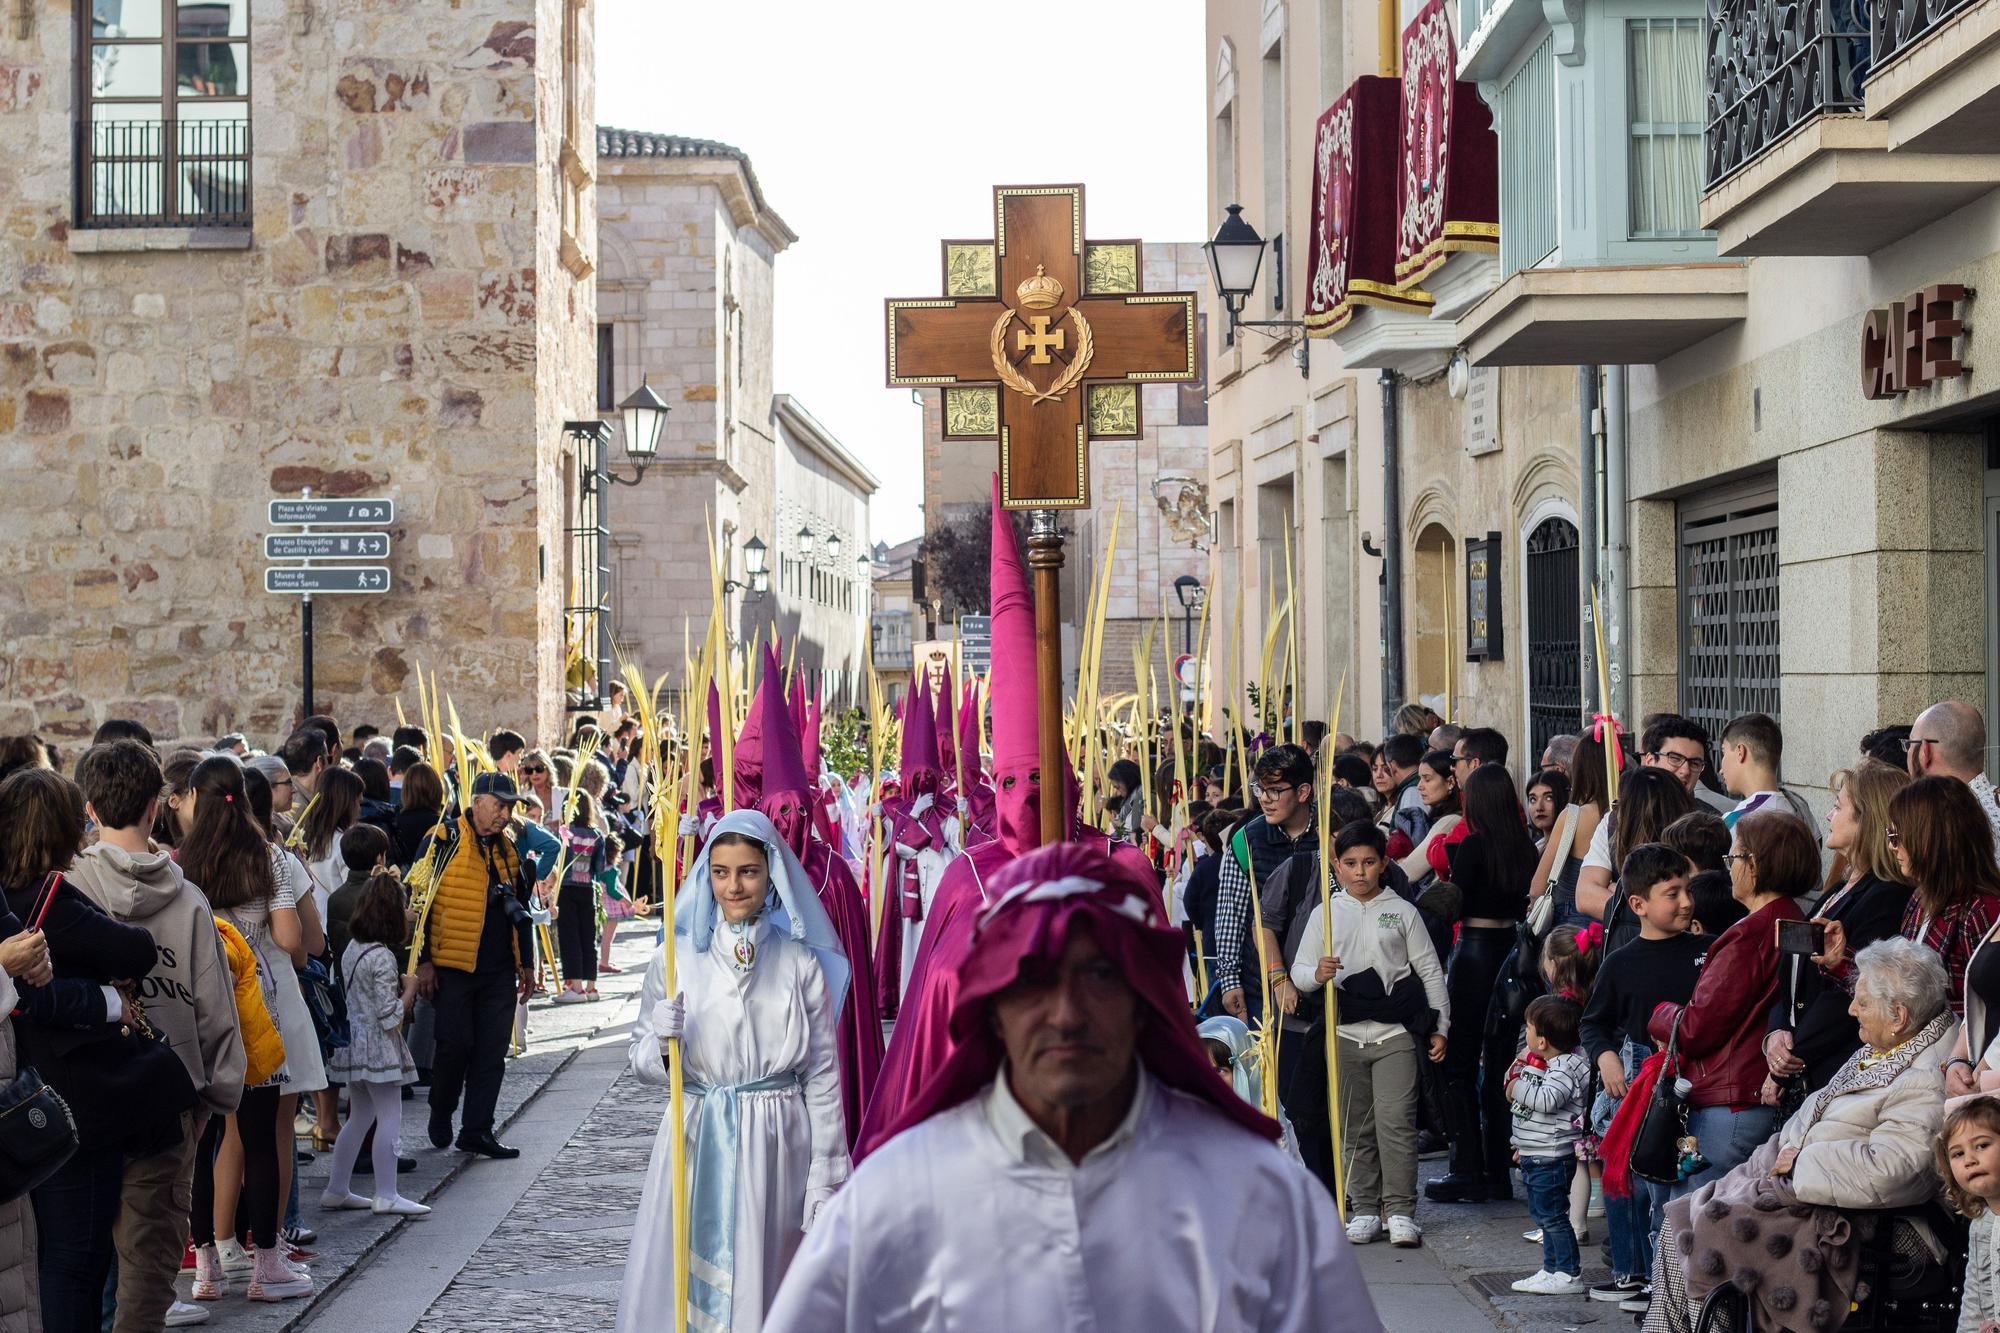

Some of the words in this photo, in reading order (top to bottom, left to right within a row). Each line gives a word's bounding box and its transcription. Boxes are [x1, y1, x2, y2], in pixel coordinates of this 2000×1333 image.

[1861, 284, 1964, 400] CAFE
[277, 504, 295, 512] Plaza
[295, 504, 304, 512] de
[305, 504, 328, 512] Viriato
[277, 512, 317, 521] Información
[273, 538, 295, 546] Museo
[296, 537, 334, 547] Etnográfico
[273, 546, 282, 554] de
[283, 546, 307, 554] Castilla
[274, 571, 296, 579] Museo
[296, 571, 305, 579] de
[274, 579, 299, 588] Semana
[300, 579, 319, 588] Santa
